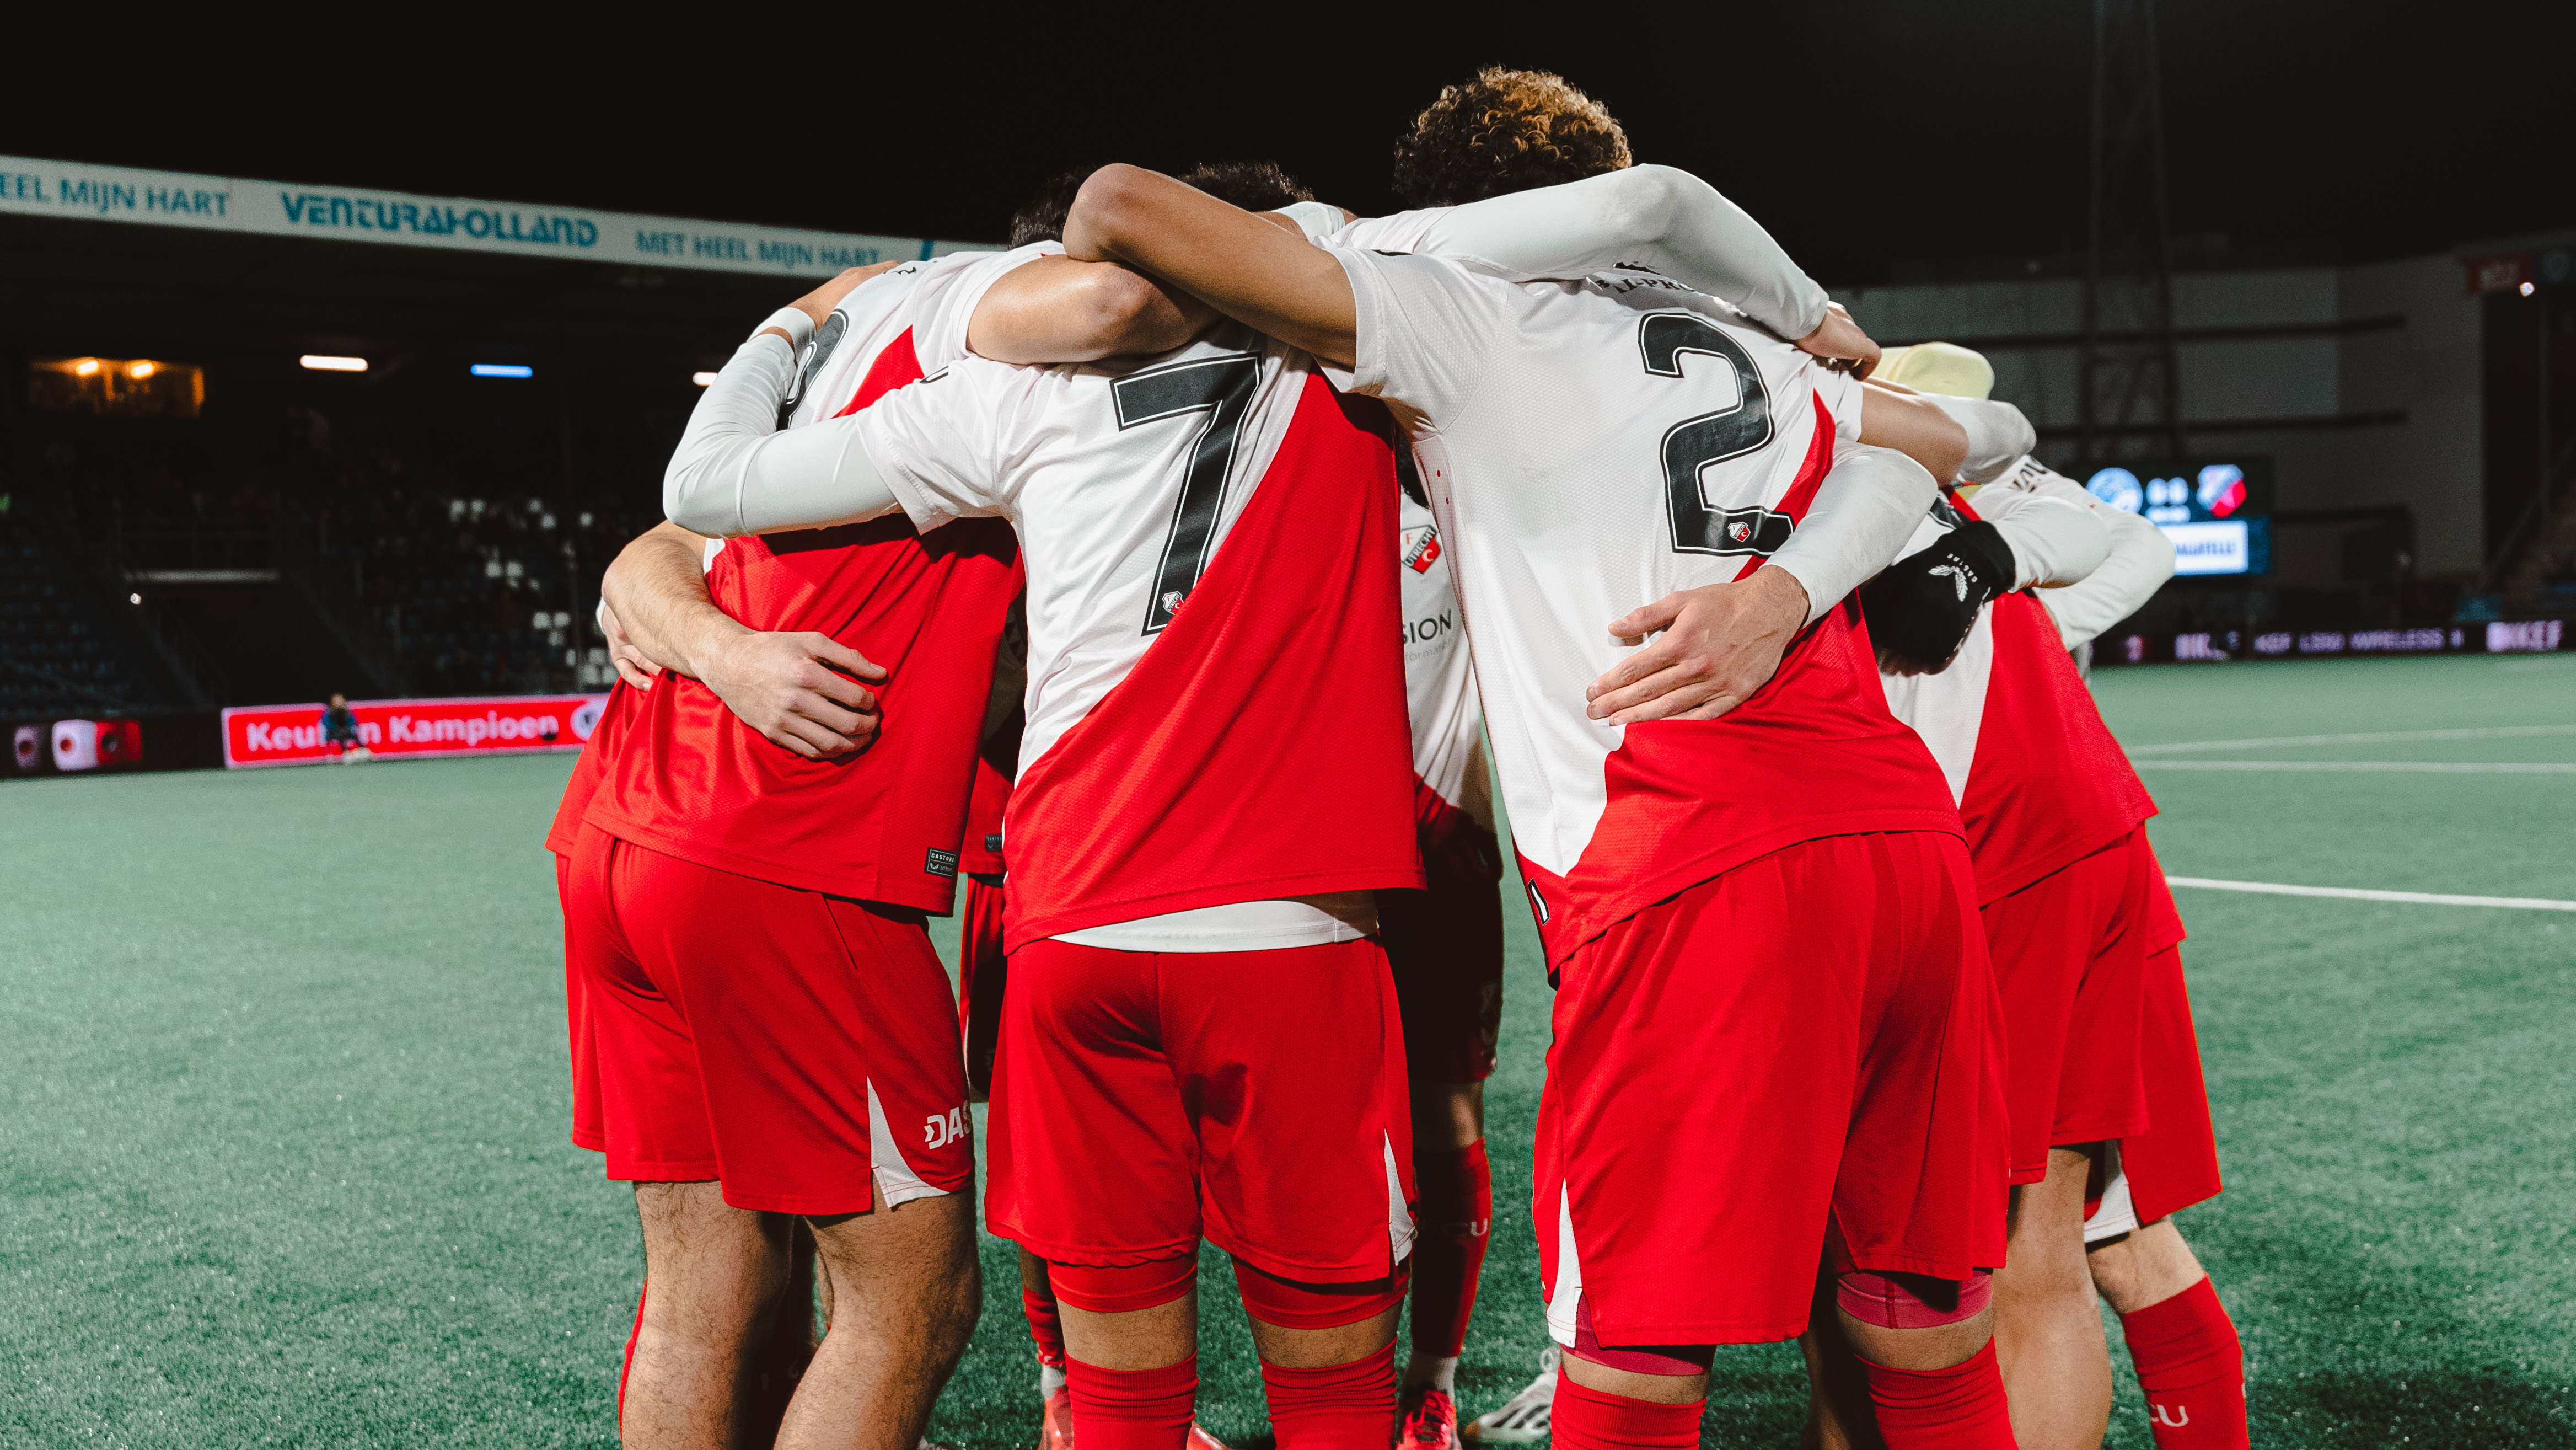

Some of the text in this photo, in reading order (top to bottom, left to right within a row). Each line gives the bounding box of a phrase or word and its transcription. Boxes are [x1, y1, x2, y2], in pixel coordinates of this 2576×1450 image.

[61, 179, 136, 215] MIJN
[147, 186, 230, 217] HART
[636, 229, 879, 269] MET HEEL MIJN HART
[1638, 312, 1796, 558] 2
[1109, 351, 1264, 636] 7
[1404, 527, 1436, 567] UTRECHT
[1421, 548, 1435, 563] C
[246, 710, 559, 752] Keun Kampioen
